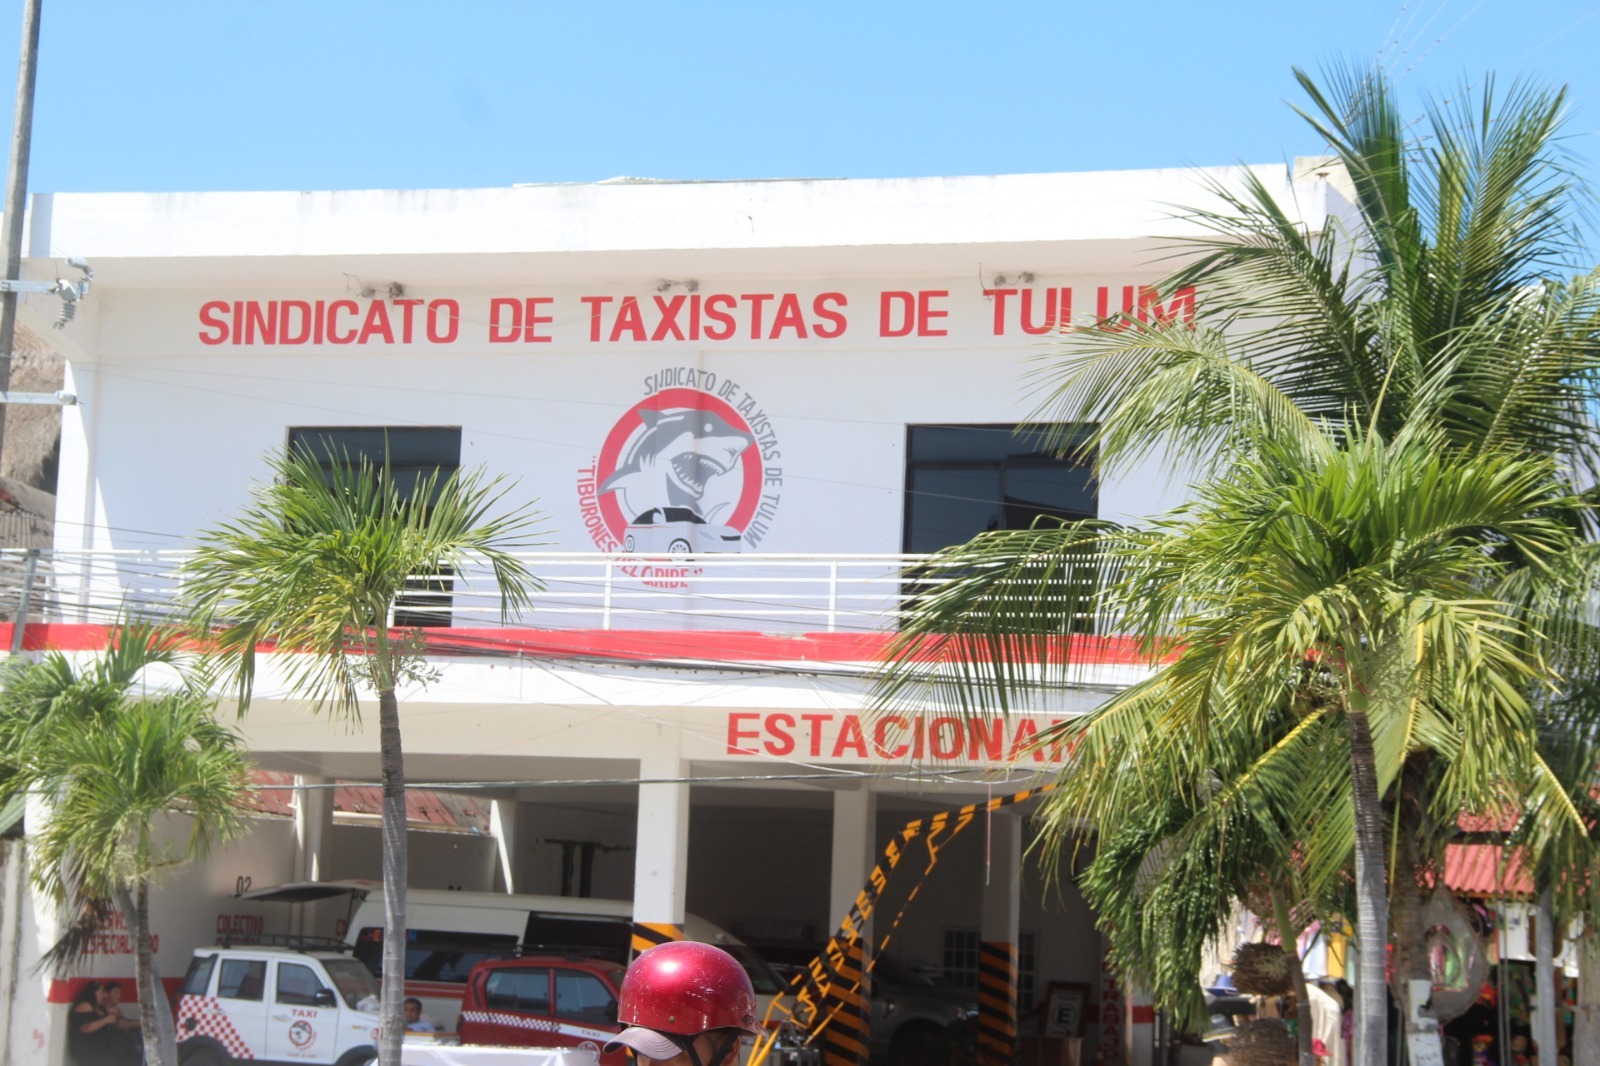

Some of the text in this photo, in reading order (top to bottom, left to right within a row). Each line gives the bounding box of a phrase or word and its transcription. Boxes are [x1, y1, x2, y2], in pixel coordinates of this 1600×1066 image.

[200, 285, 1196, 346] SINDICATO DE TAXISTAS DE TULUM
[644, 366, 783, 549] SINDICATO DE TAXISTAS DE TULUM
[216, 914, 265, 934] COLECTIVO
[291, 1008, 318, 1019] TAXI
[1057, 1007, 1072, 1024] E
[1103, 979, 1120, 1059] TRABAJO
[581, 1029, 601, 1038] TAXI
